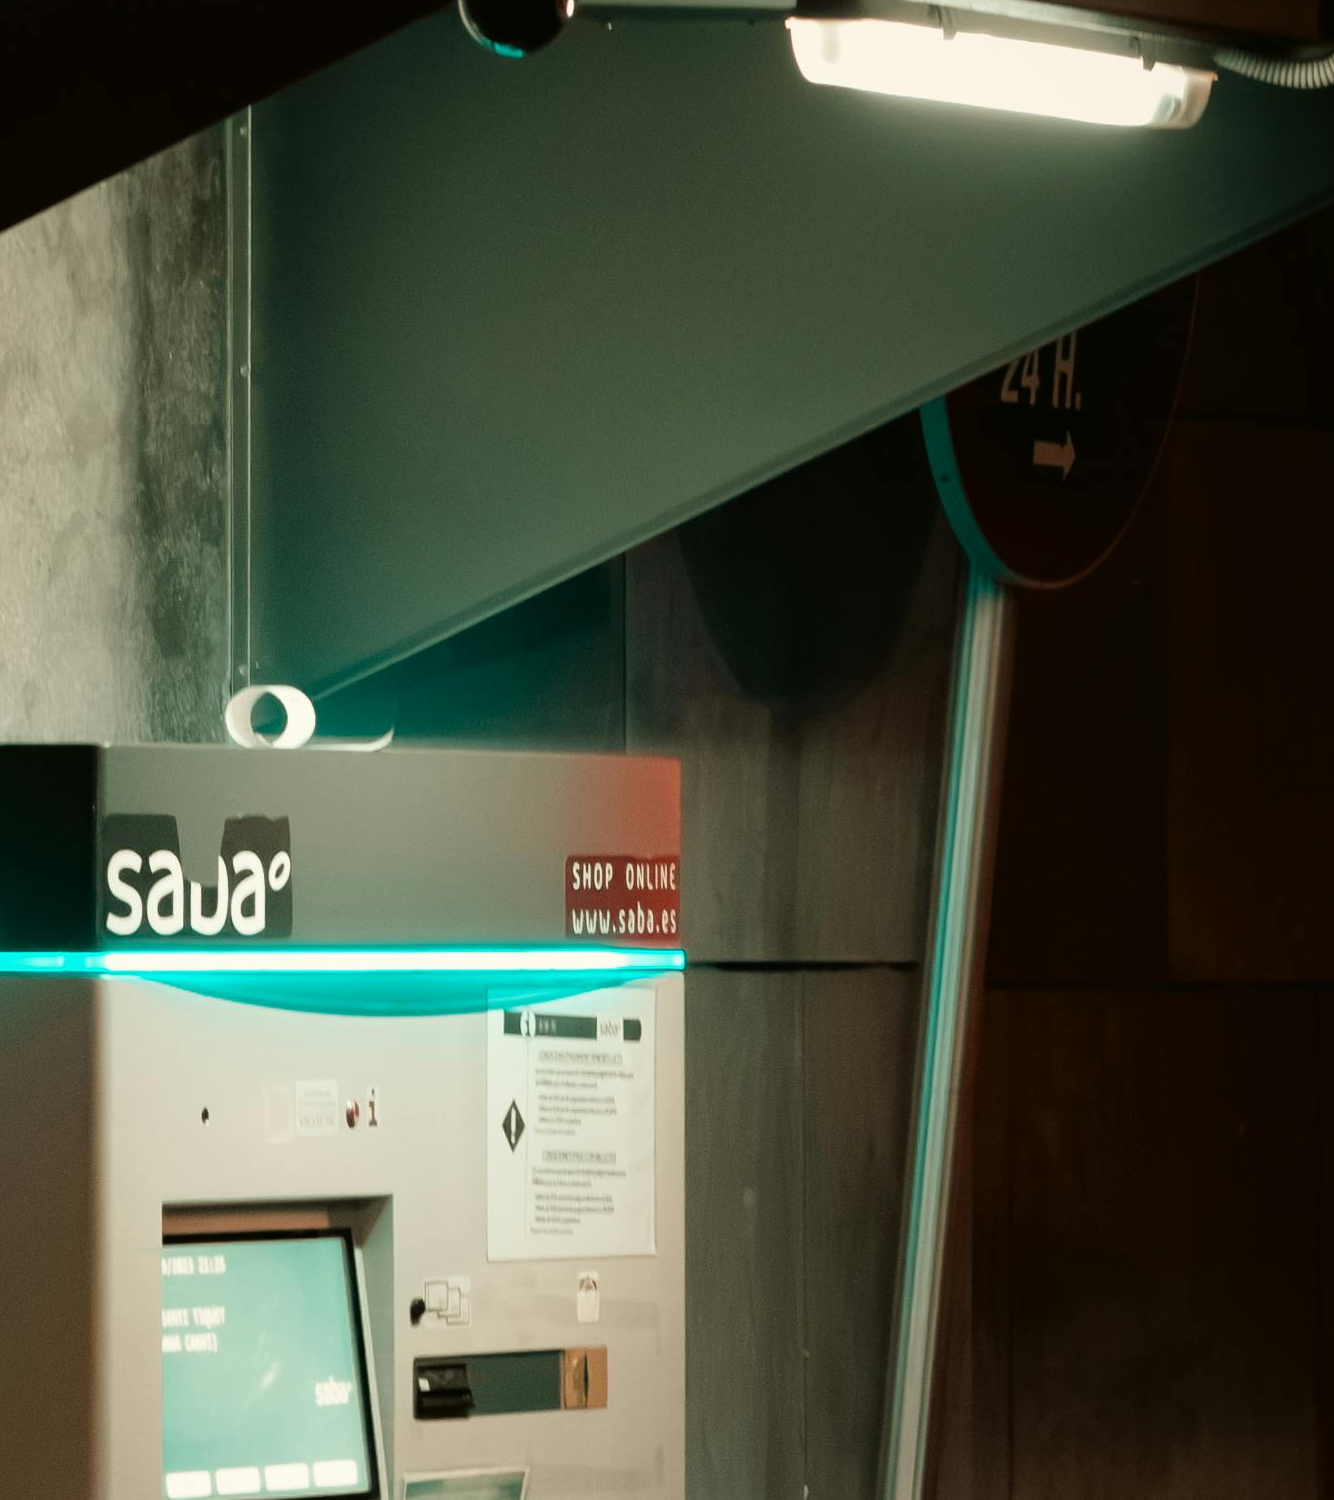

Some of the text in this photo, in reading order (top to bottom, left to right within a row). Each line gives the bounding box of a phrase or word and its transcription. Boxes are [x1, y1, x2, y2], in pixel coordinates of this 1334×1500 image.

[572, 861, 676, 891] SHOP ONLINE
[571, 900, 677, 935] www.saba.es
